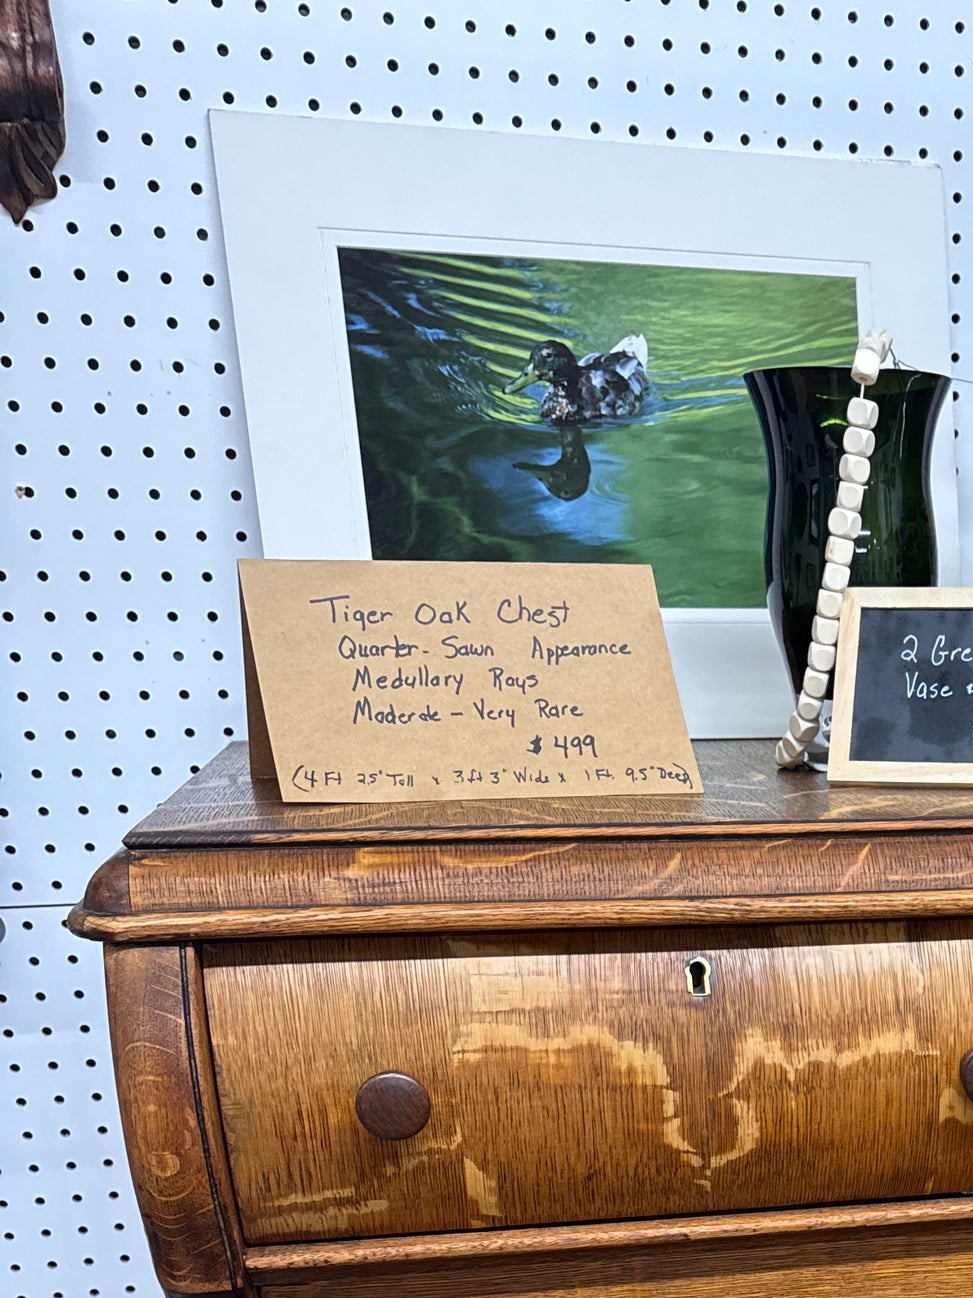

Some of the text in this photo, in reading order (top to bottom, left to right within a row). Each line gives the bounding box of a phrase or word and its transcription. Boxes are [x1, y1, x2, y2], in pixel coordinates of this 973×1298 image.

[309, 595, 394, 631] Tiger
[497, 595, 570, 628] Chest
[441, 635, 495, 659] Sawn
[531, 635, 632, 666] Appearance
[901, 634, 918, 663] 2
[352, 664, 539, 696] Medullary Rays
[905, 671, 953, 699] Vase
[473, 698, 516, 729] Very
[534, 698, 584, 719] Rare
[554, 734, 598, 759] 499
[513, 766, 550, 784] Wide
